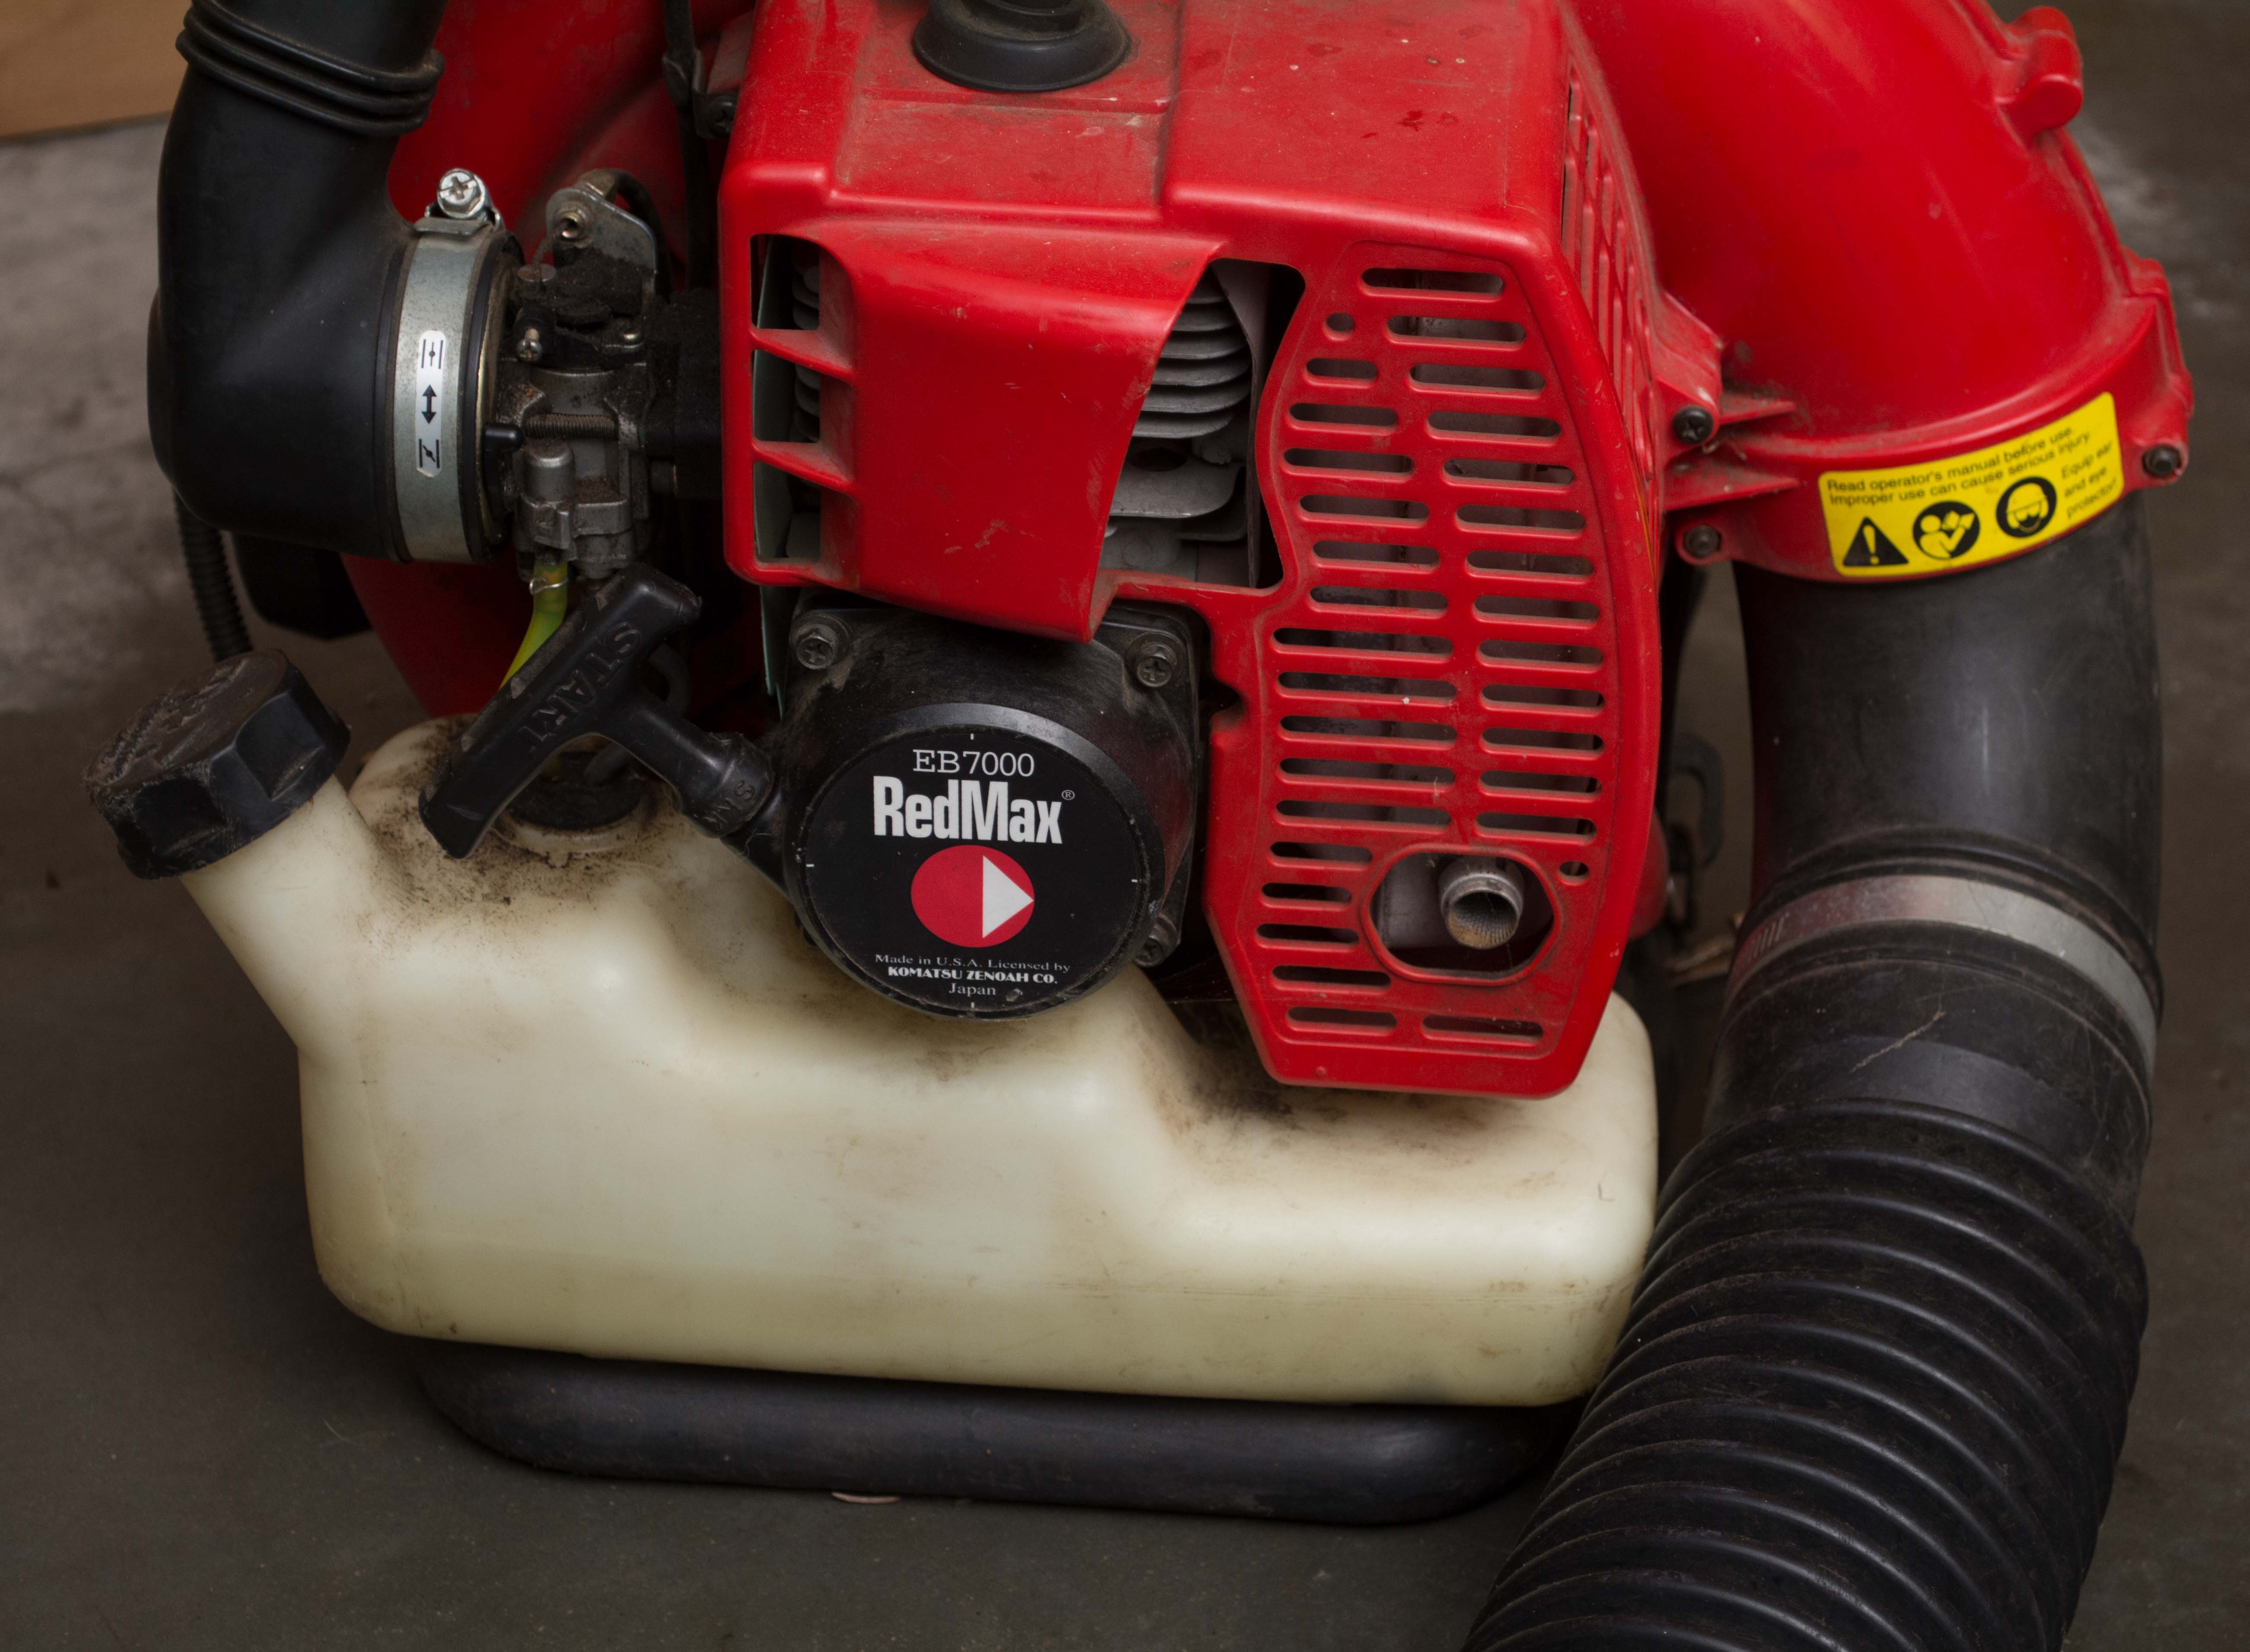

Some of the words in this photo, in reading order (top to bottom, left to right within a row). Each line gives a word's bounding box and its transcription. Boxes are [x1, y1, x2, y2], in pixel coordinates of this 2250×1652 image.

[1827, 479, 1865, 491] Read
[1870, 471, 1942, 490] operator's
[1947, 455, 2000, 478] manual
[2003, 439, 2046, 462] before
[2061, 455, 2094, 479] Equip
[2097, 441, 2112, 458] ear
[1830, 492, 1893, 507] Improper
[1899, 489, 1924, 501] use
[1930, 481, 1957, 496] can
[1960, 470, 2003, 490] cause
[2008, 450, 2055, 474] serious
[2065, 478, 2086, 497] and
[2089, 466, 2107, 484] eye
[518, 621, 641, 754] START
[913, 749, 1035, 777] EB7000
[875, 954, 913, 964] Made
[919, 956, 931, 964] in
[936, 957, 983, 967] U.S.A.
[988, 959, 1049, 971] Licensed
[1054, 962, 1071, 973] by
[888, 966, 963, 980] KOMATSU
[966, 970, 1029, 983] ZENOAH
[1032, 973, 1058, 984] CO.
[949, 982, 996, 997] Japan
